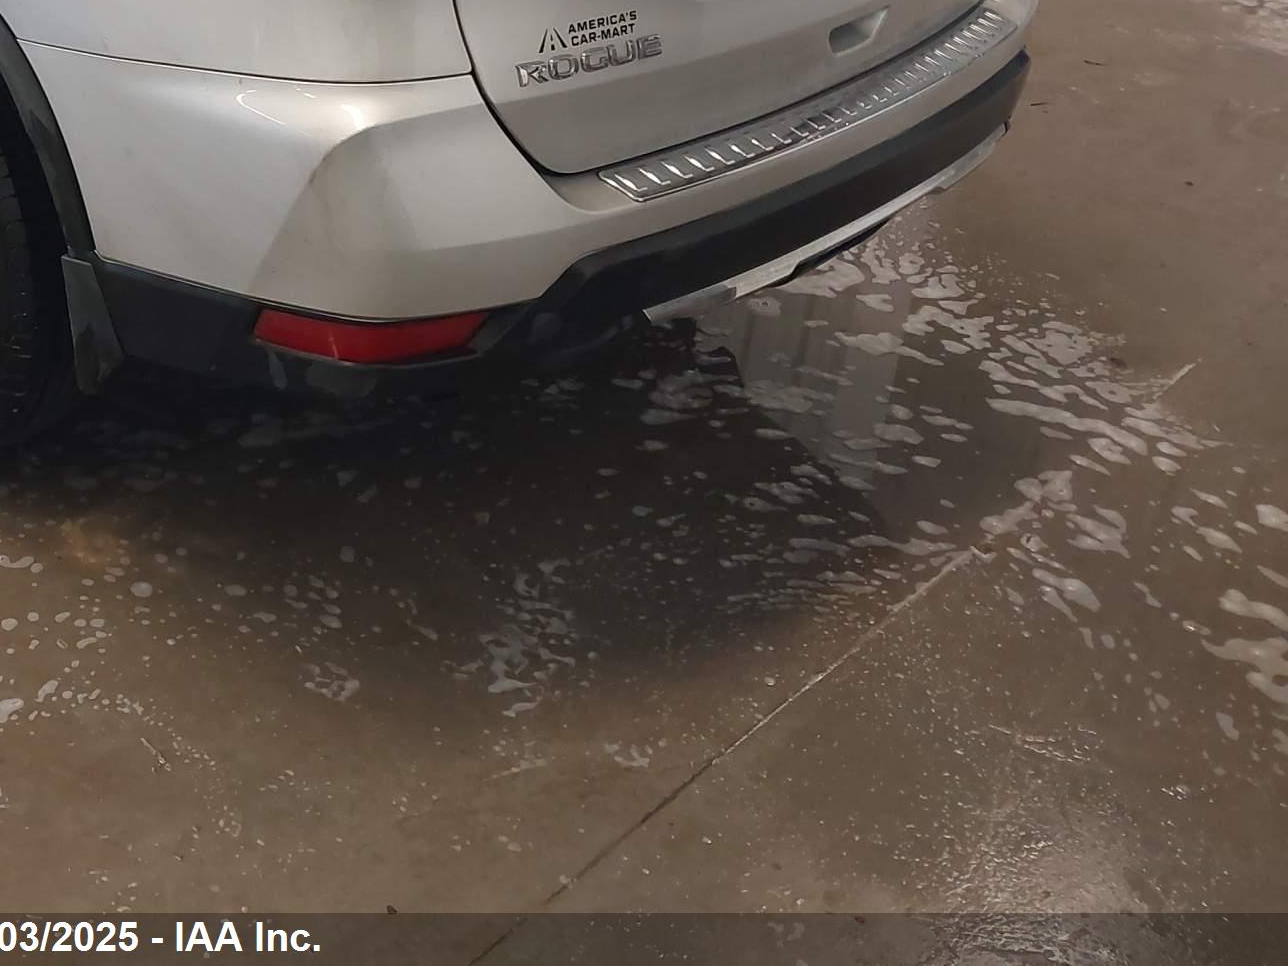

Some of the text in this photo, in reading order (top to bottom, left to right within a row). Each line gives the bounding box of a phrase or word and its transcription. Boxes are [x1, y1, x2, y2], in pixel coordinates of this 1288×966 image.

[568, 10, 637, 35] AMERICA'S
[571, 23, 636, 47] CAR-MART
[515, 34, 662, 87] ROGUE
